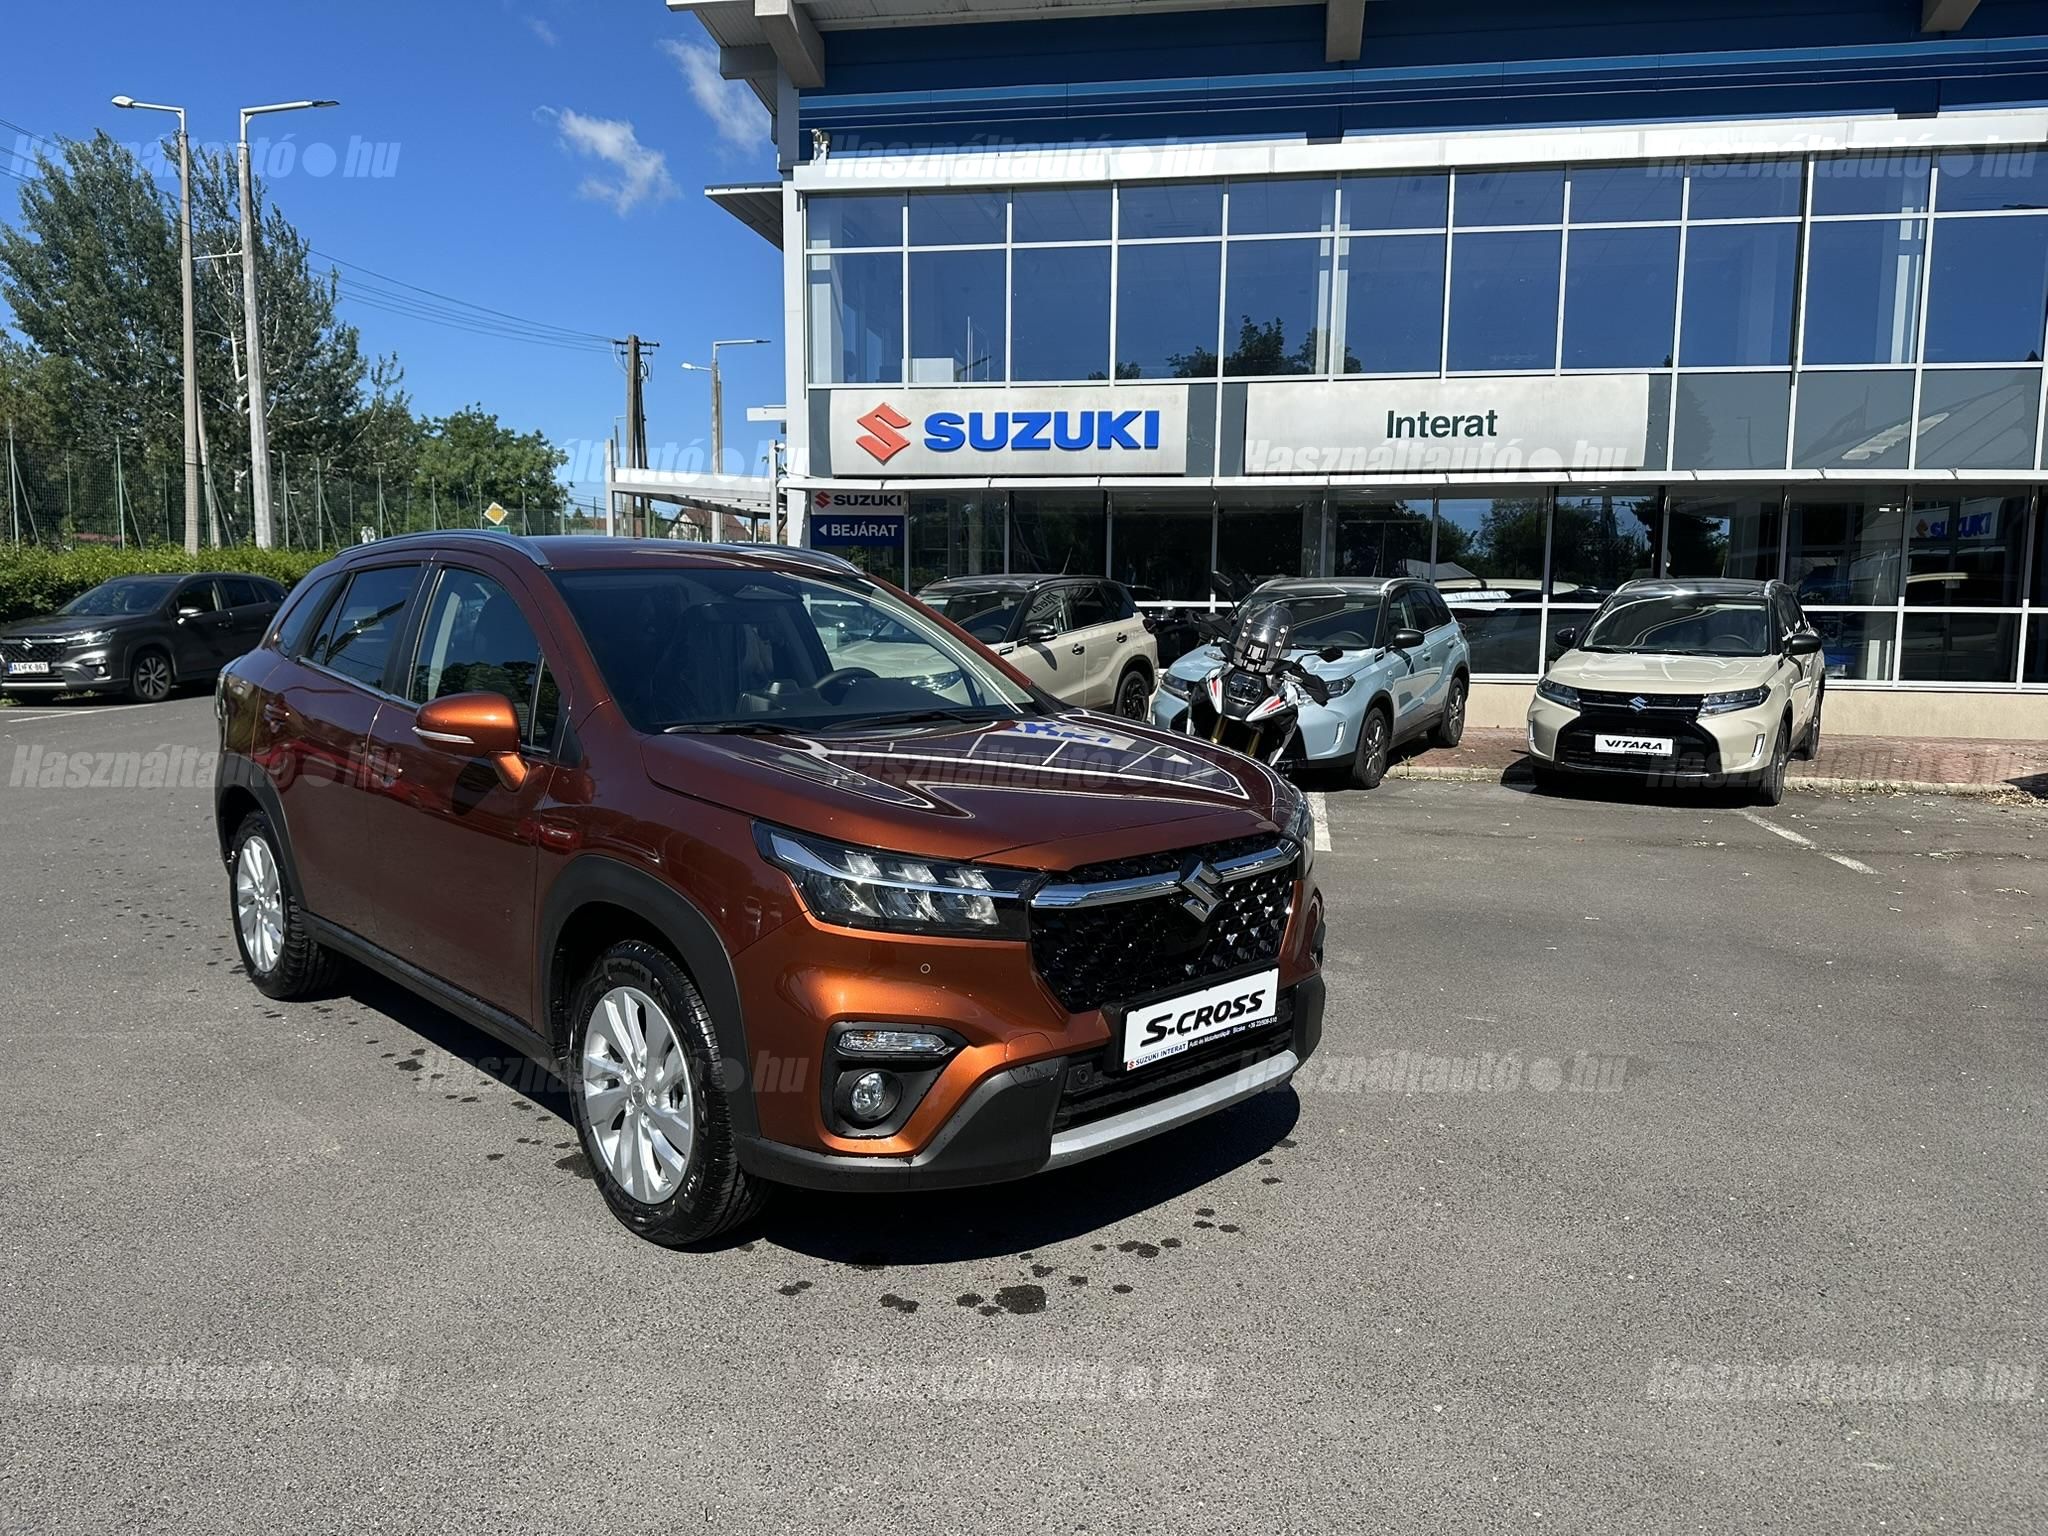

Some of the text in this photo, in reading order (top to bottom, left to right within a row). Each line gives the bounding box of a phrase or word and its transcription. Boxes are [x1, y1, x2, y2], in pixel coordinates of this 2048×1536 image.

[924, 409, 1160, 451] SUZUKI
[1386, 409, 1498, 438] Interat
[833, 494, 902, 506] SUZUKI
[831, 521, 898, 537] BEJÁRAT
[1604, 739, 1663, 751] VITARA
[1135, 1053, 1159, 1066] SUZUKI
[1160, 1042, 1187, 1060] INTERAT
